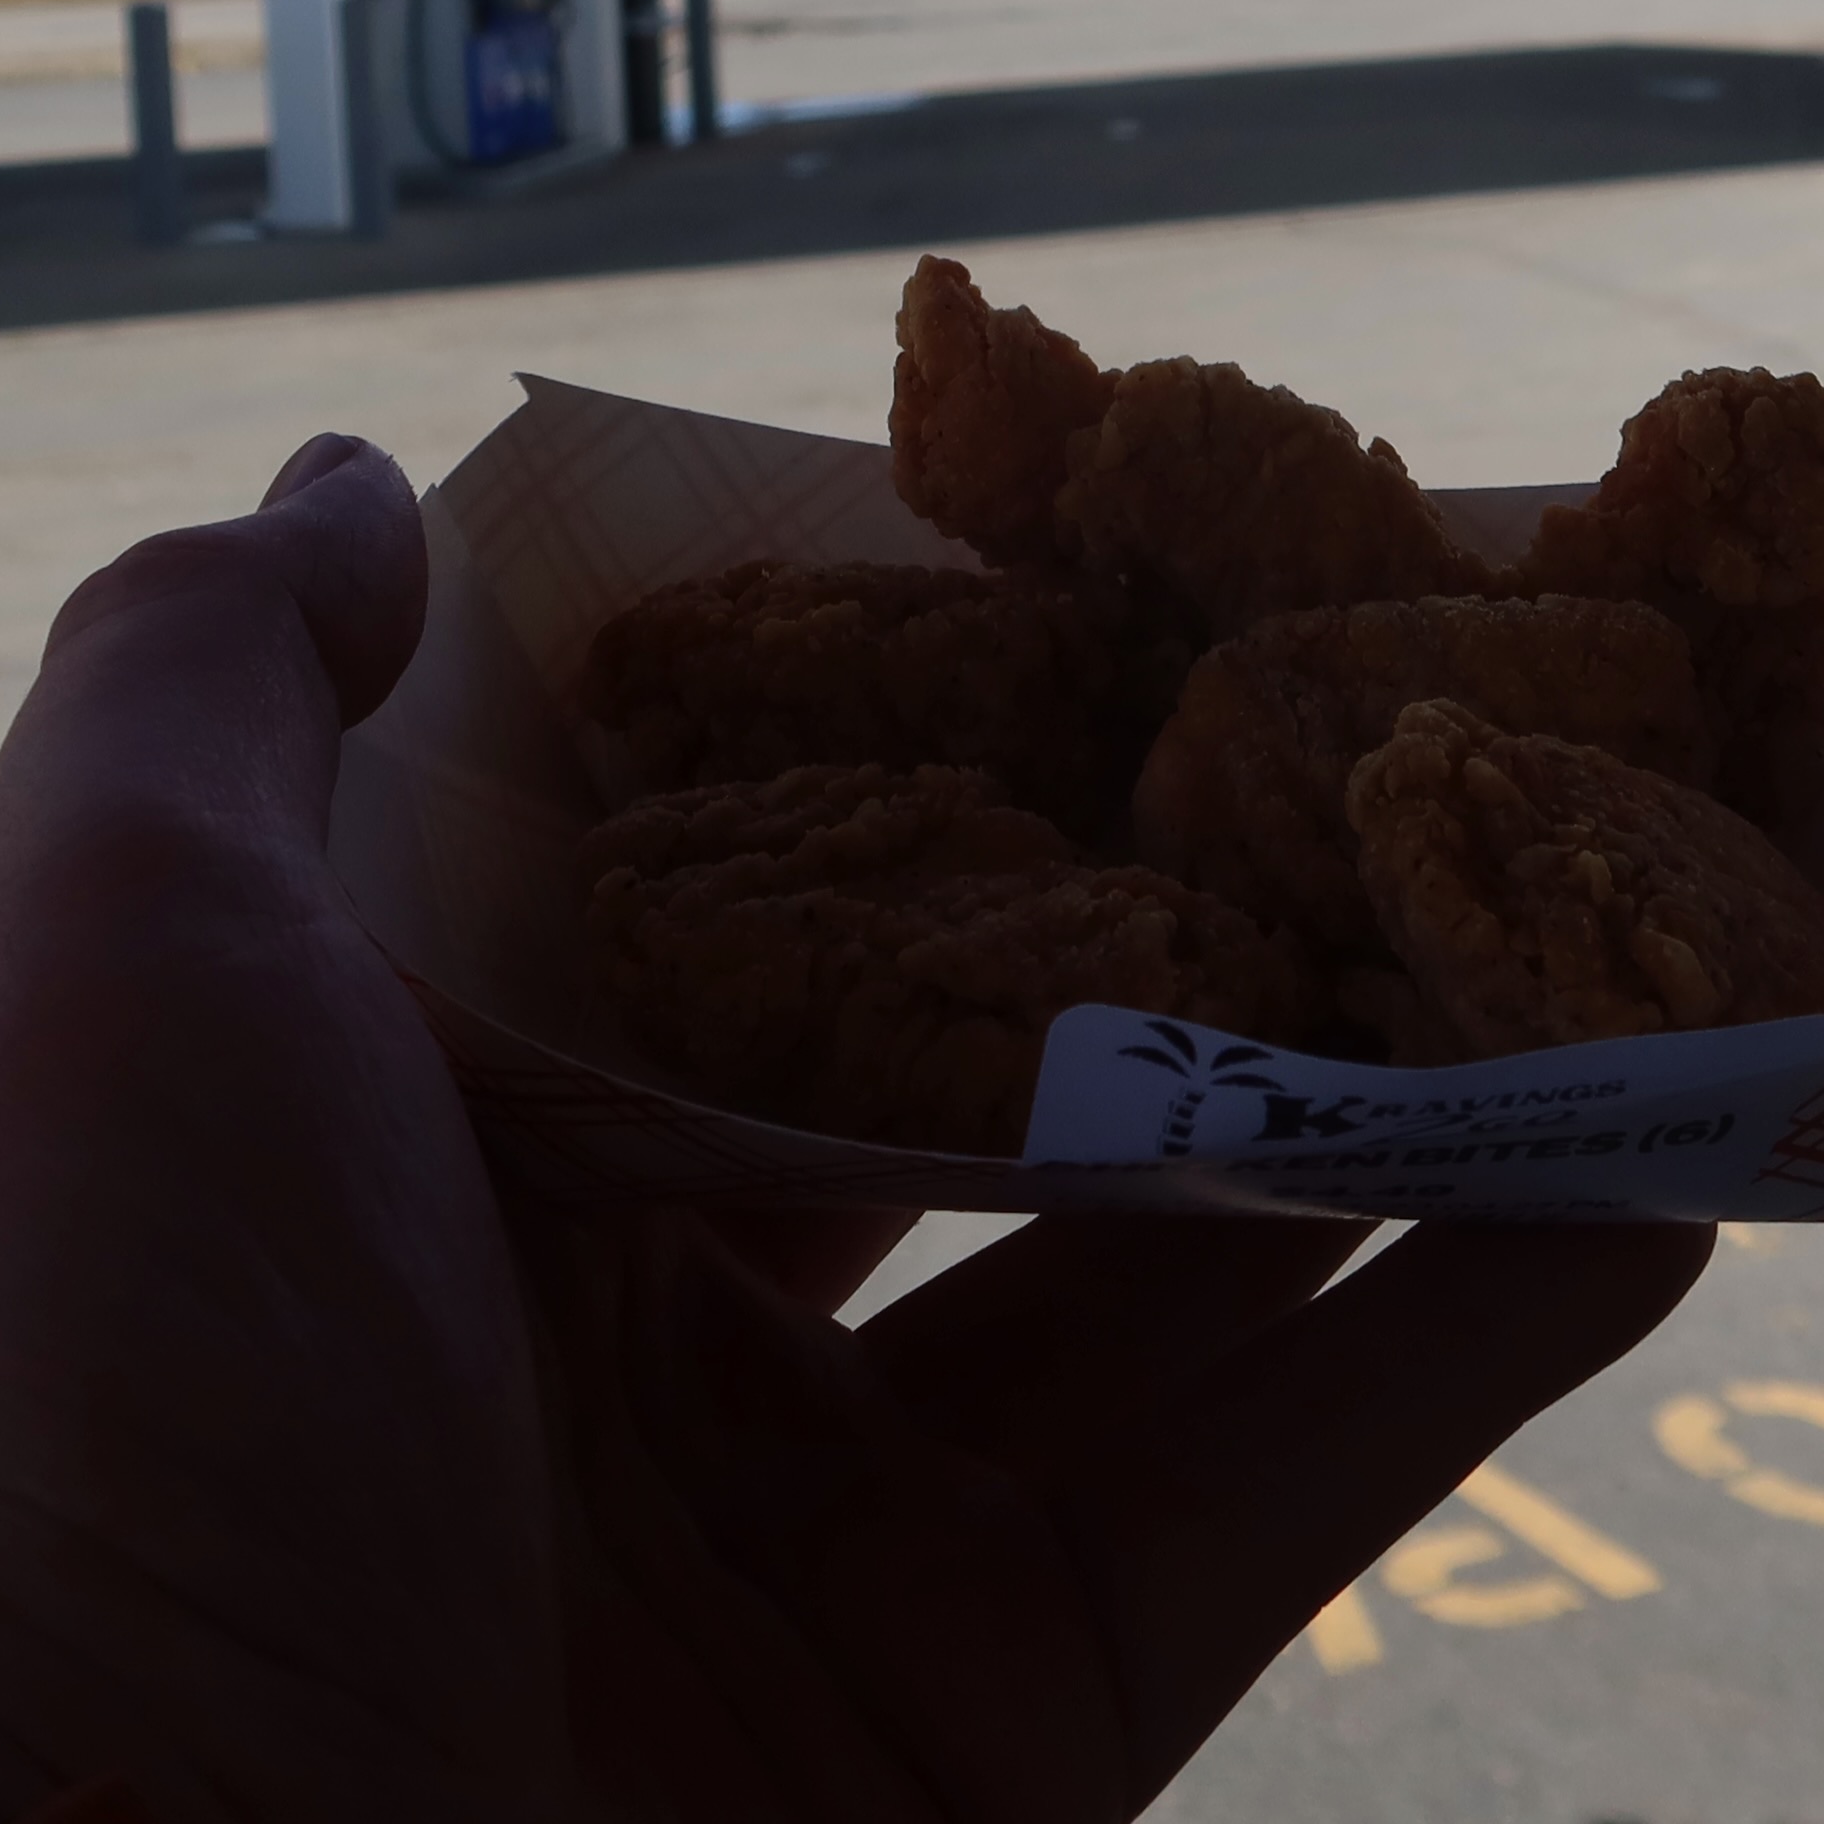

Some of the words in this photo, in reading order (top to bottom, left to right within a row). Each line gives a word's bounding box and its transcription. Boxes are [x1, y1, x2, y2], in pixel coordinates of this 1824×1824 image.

[1252, 1079, 1626, 1142] KRAVINGS
[1400, 1130, 1627, 1167] BITES
[1638, 1113, 1736, 1155] (6)
